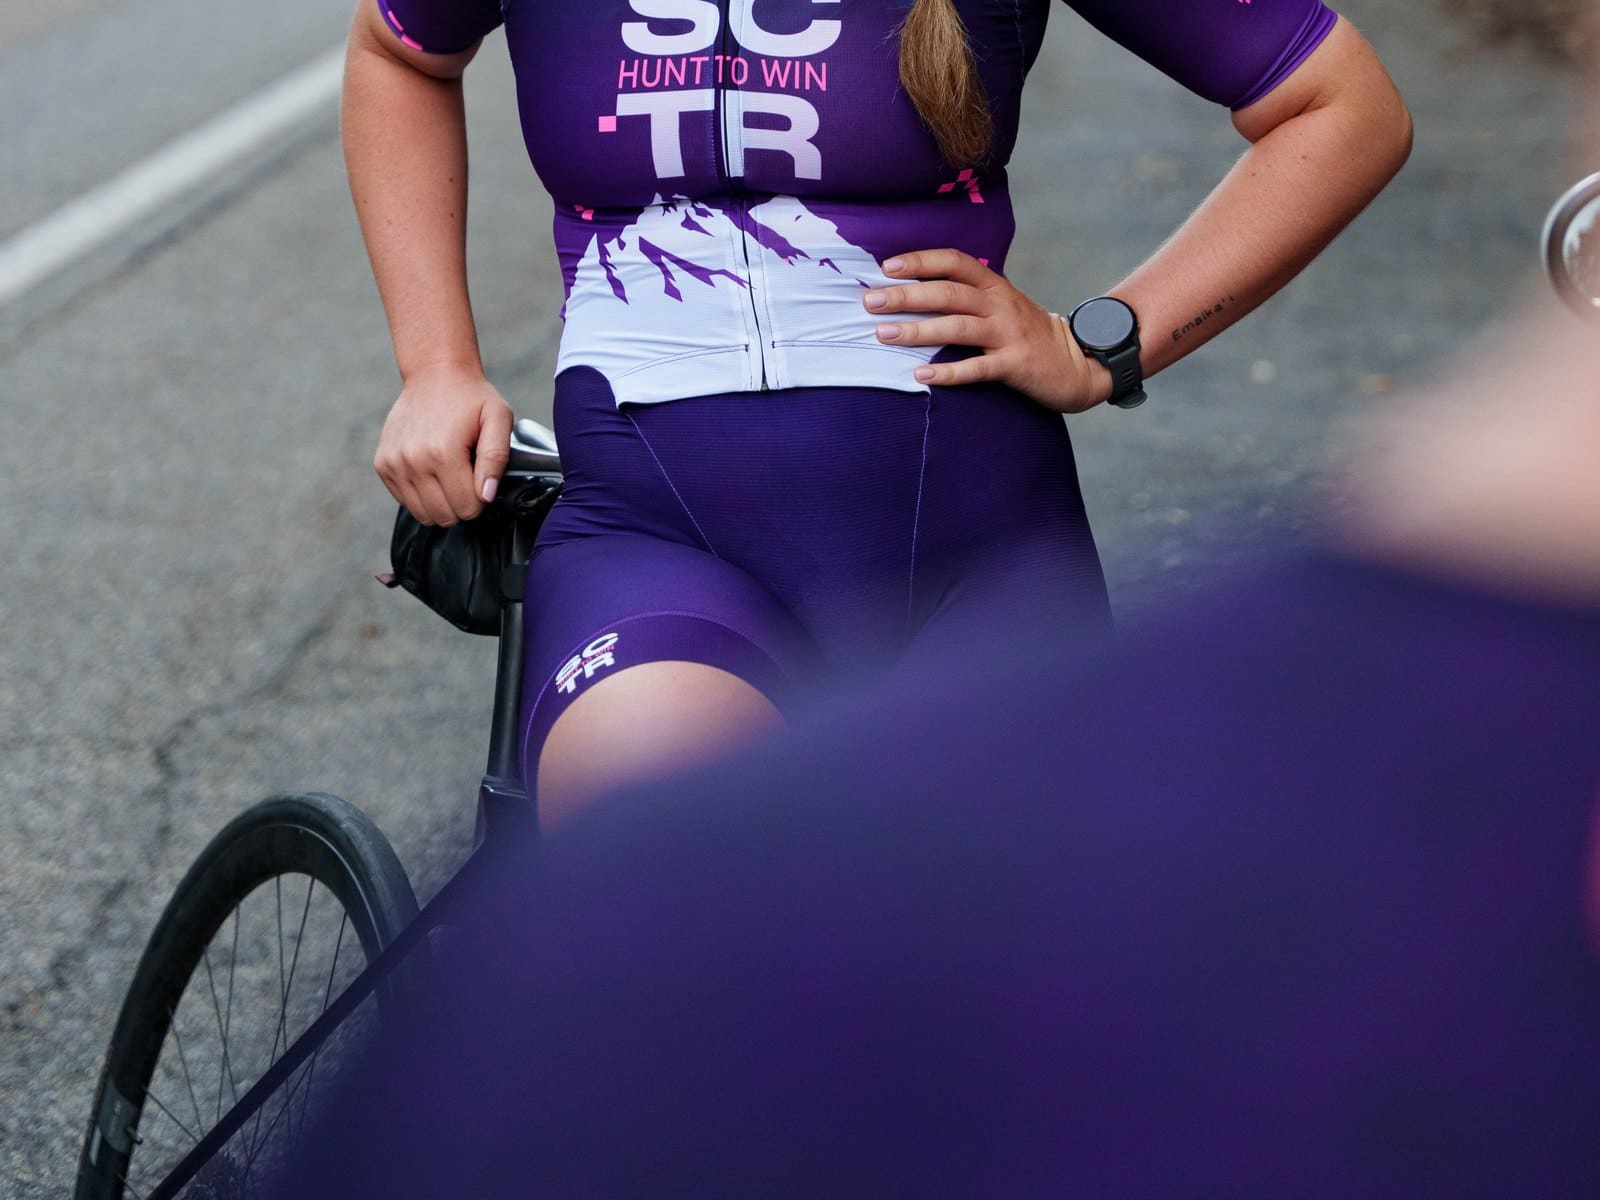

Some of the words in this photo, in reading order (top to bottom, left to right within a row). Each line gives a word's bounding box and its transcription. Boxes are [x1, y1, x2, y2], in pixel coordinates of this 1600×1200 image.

[618, 56, 709, 88] HUNT
[715, 55, 748, 85] TO
[760, 59, 827, 91] WIN
[616, 89, 822, 180] TR
